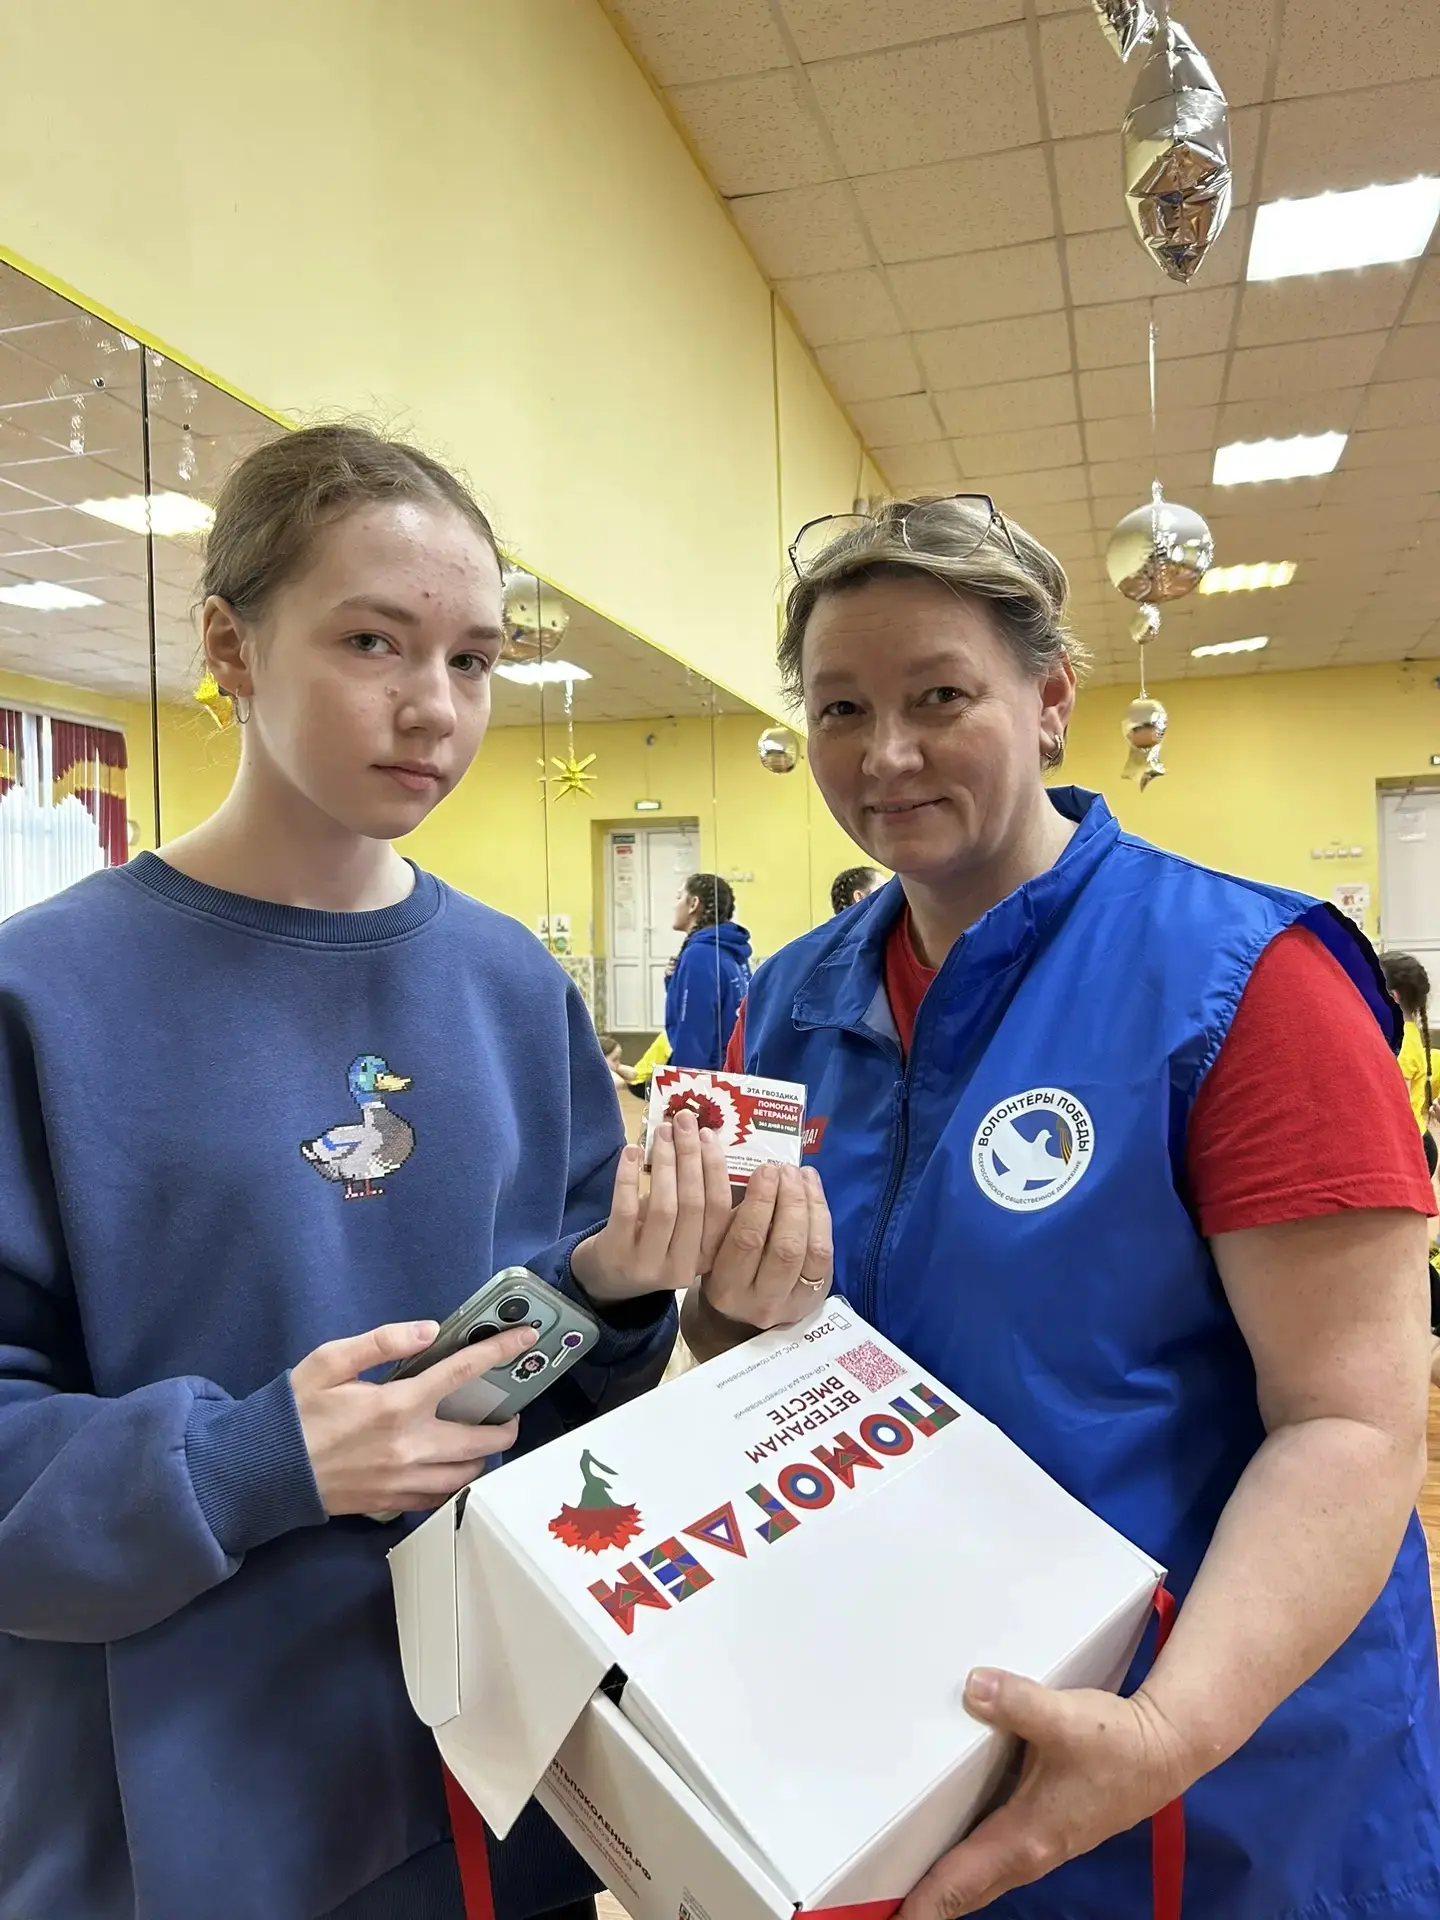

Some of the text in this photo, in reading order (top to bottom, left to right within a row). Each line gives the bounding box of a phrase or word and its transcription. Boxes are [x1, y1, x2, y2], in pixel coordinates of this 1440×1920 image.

[746, 1087, 799, 1101] ЭТА ГВОЗДИКА
[753, 1108, 798, 1122] ВЕТЕРАНАМ
[758, 1100, 799, 1113] ПОМОГАЕТ
[768, 1122, 780, 1130] ДНЕЙ
[978, 1092, 1090, 1152] ВОЛОНТЁРЫ ПОБЕДЫ
[978, 1152, 1082, 1205] ВСЕРОССИЙСКОЕ ОБЩЕСТВЕННОЕ ДВИЖЕНИЕ
[716, 1323, 835, 1389] 2206 СМС для пожертвований
[733, 1365, 826, 1420] QR-код для пожертвований
[766, 1375, 845, 1426] ВМЕСТЕ
[744, 1389, 862, 1464] ВЕТЕРАНАМ
[586, 1382, 962, 1636] ПОМОГАЕМ
